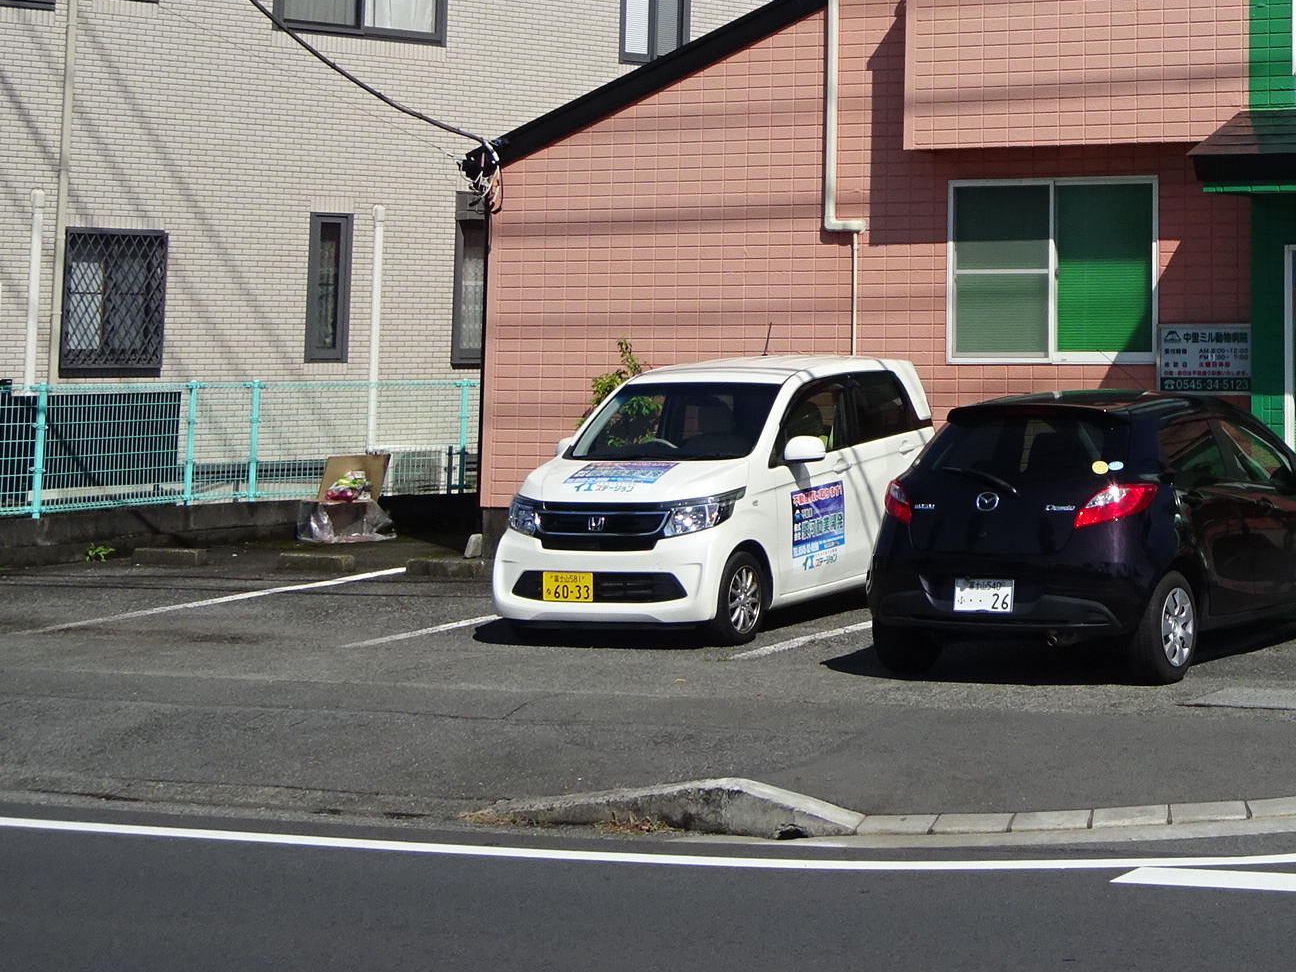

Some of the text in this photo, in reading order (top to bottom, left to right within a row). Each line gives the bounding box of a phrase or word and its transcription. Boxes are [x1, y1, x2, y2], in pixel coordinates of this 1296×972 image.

[1183, 332, 1249, 343] 中里ミル動物病院
[554, 584, 590, 599] 60-33
